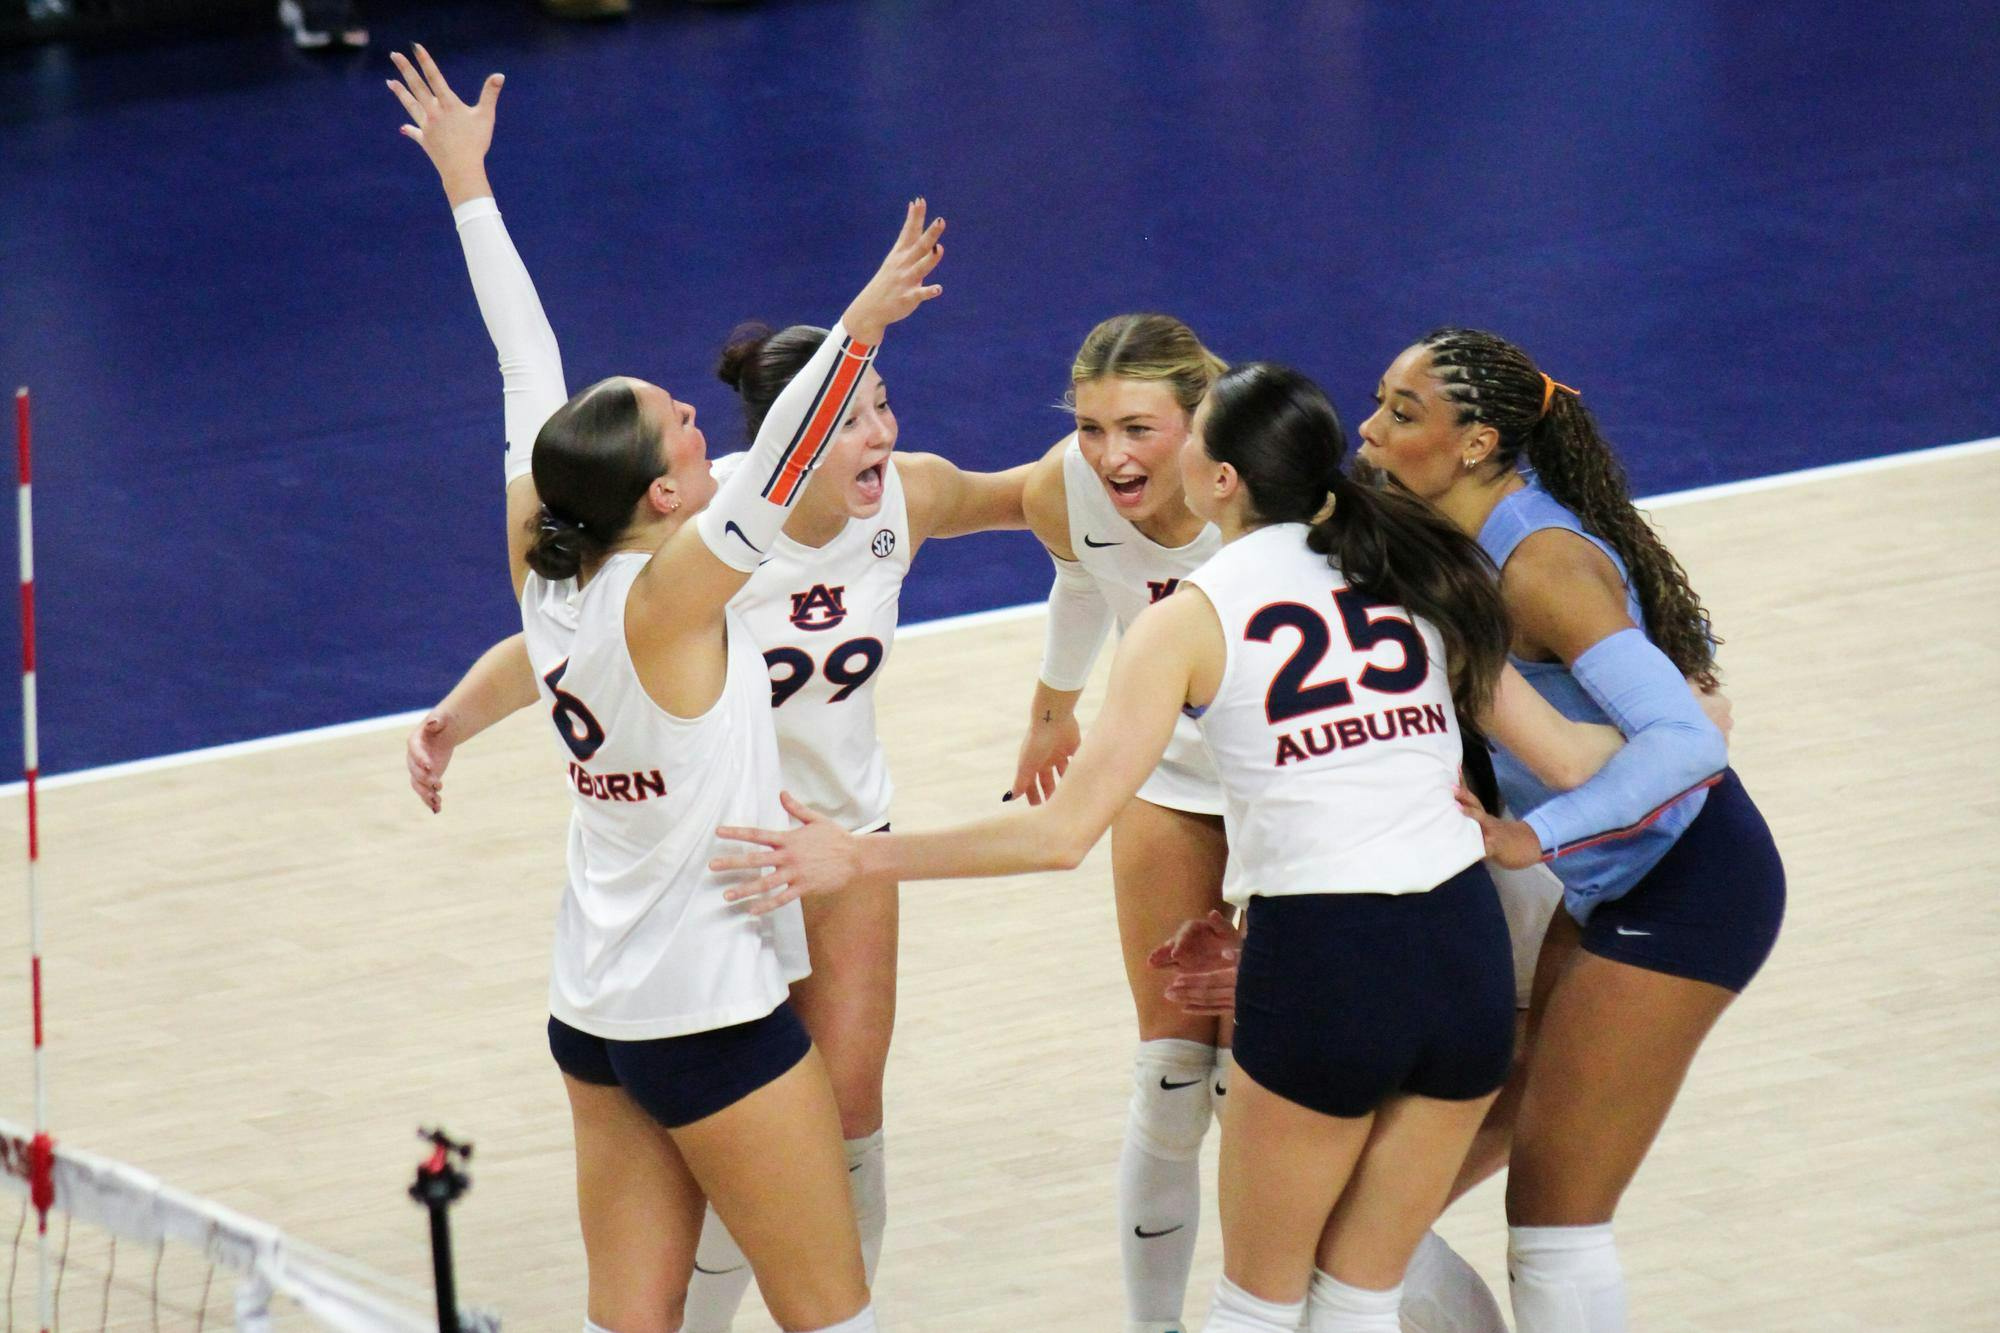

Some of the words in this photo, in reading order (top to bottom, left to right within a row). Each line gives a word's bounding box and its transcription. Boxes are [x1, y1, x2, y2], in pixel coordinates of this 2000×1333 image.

[872, 529, 896, 558] SEC
[762, 636, 884, 709] 99
[1243, 586, 1430, 726] 25
[544, 656, 606, 762] 6
[1275, 703, 1449, 768] AUBURN
[569, 761, 668, 803] BURN
